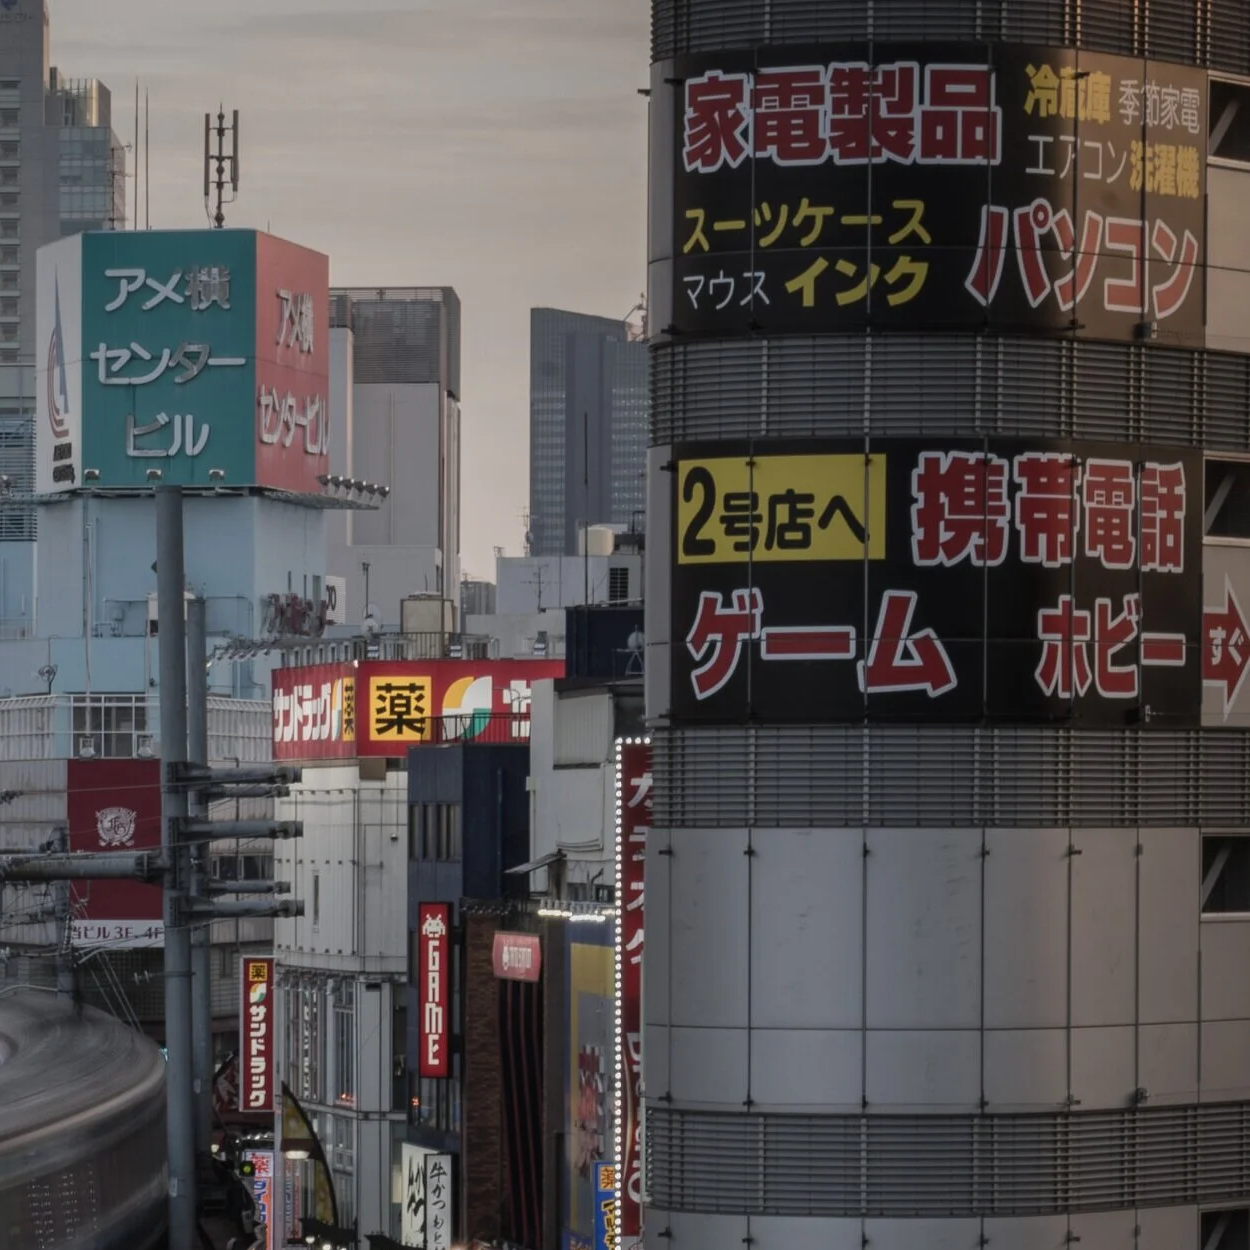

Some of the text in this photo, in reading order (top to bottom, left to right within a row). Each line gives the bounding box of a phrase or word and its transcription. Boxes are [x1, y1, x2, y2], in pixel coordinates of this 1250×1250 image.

[682, 60, 1002, 173] 家電製品
[1024, 63, 1112, 125] 冷蔵庫
[1118, 78, 1201, 135] 季節家電
[1025, 134, 1127, 183] エアコン
[1130, 139, 1199, 199] 洗濯機
[683, 197, 931, 254] スーツケース
[105, 265, 230, 312] アメ横
[784, 255, 929, 308] インク
[964, 197, 1198, 320] パソコン
[682, 268, 771, 310] マウス
[276, 288, 314, 354] アメ横
[90, 341, 246, 385] センター
[126, 412, 209, 457] ビル
[258, 384, 330, 456] センタービル
[681, 466, 871, 556] 2号店へ
[910, 450, 1186, 574] 携帯電話
[686, 587, 958, 700] ゲーム
[1034, 592, 1186, 700] ホビー
[1208, 626, 1244, 669] すぐ
[274, 682, 331, 742] サンドラッグ
[376, 683, 425, 735] 薬
[251, 964, 266, 980] 薬
[424, 939, 444, 1066] GAME
[250, 1005, 267, 1107] サンドラッグ
